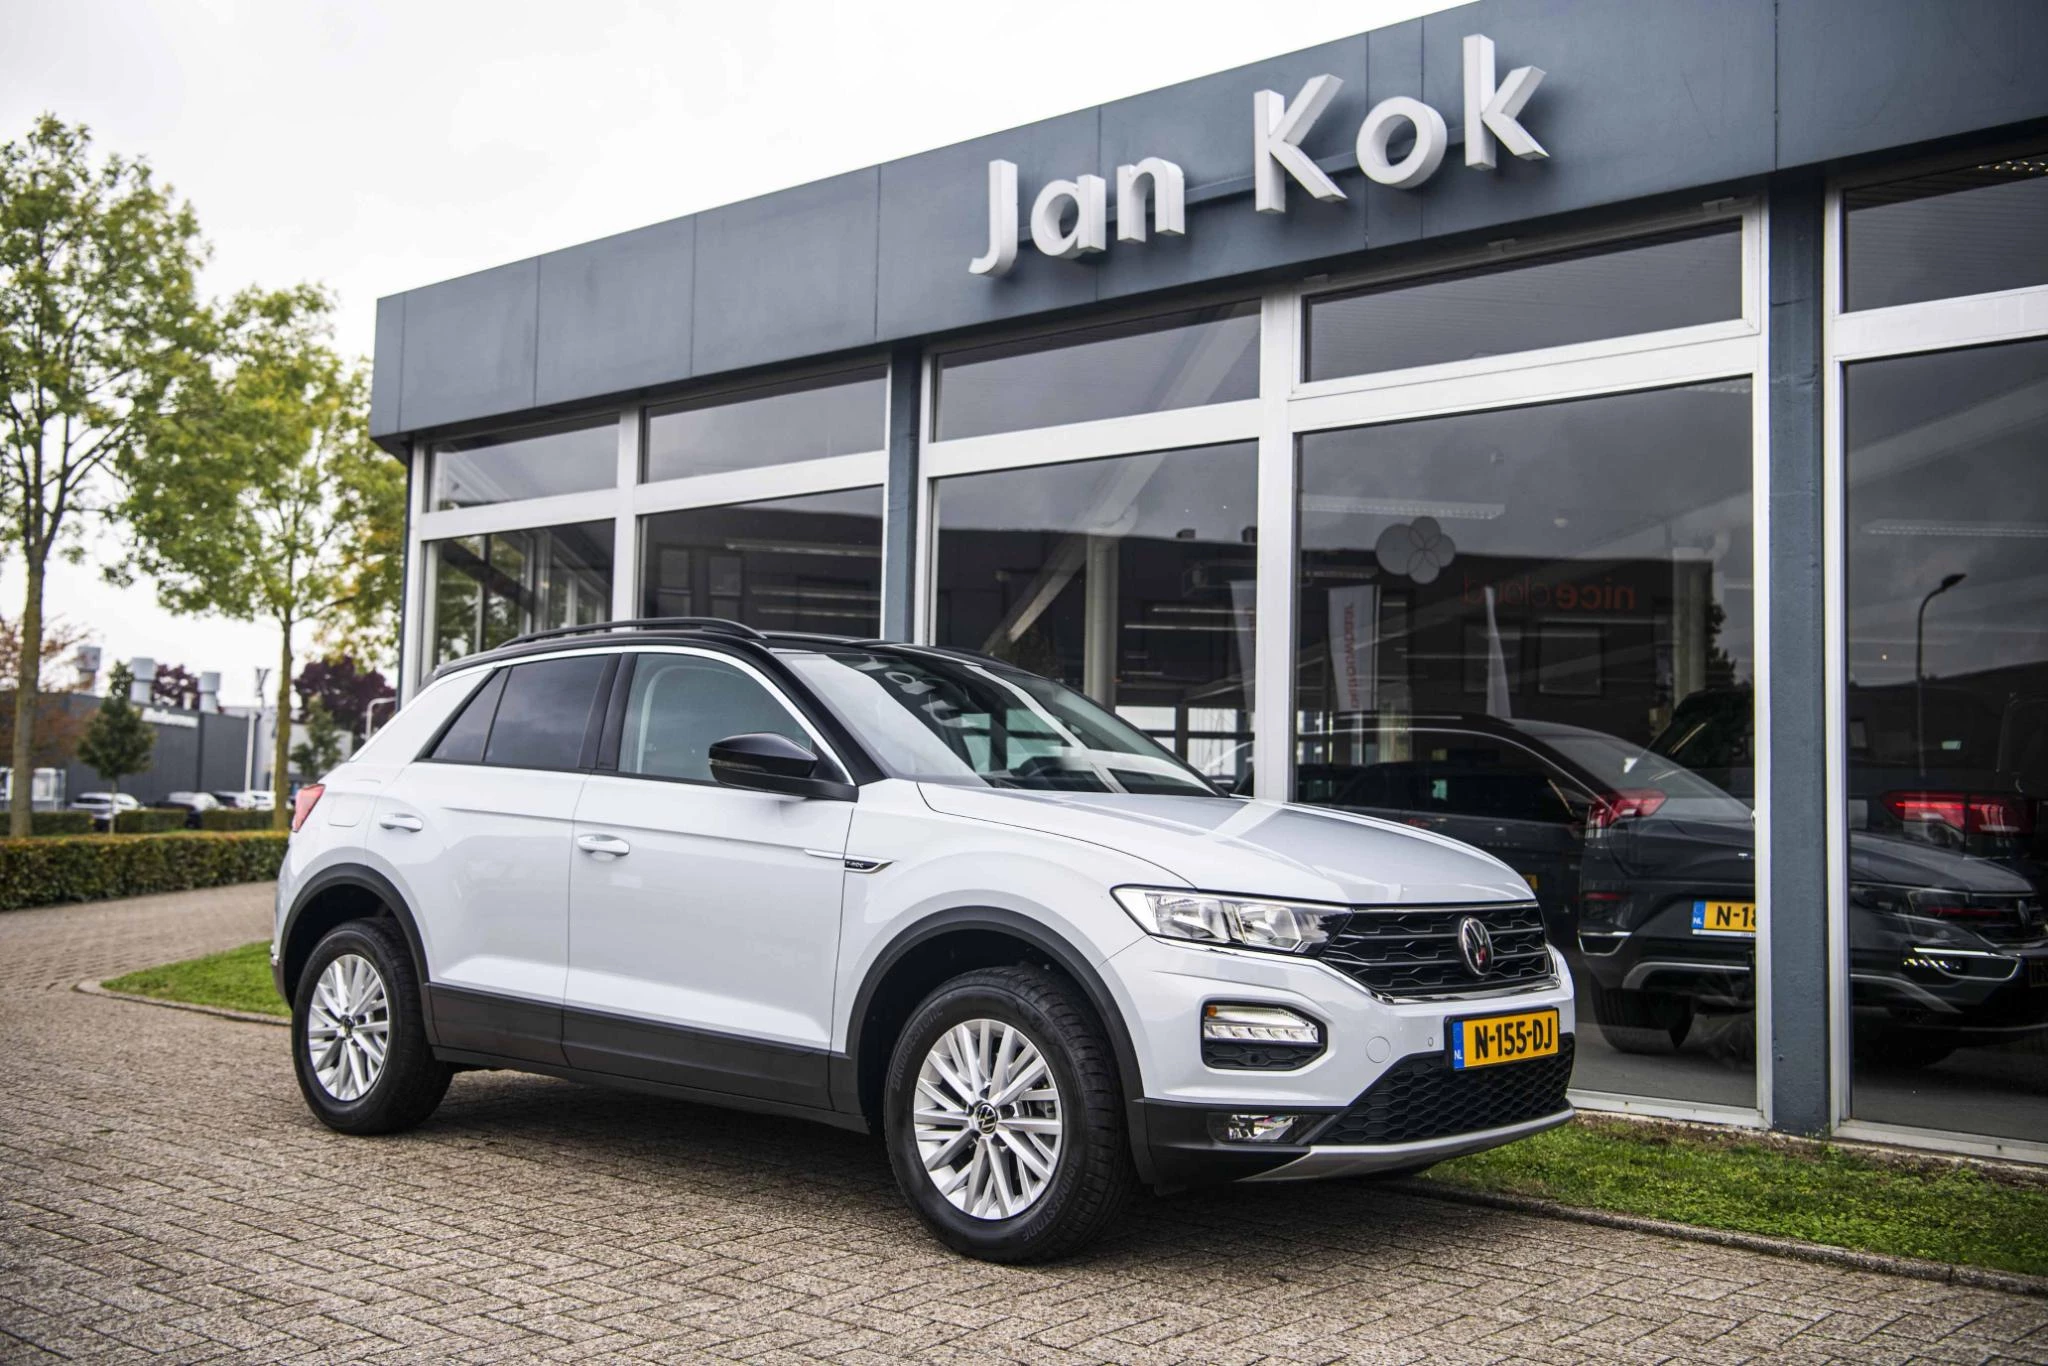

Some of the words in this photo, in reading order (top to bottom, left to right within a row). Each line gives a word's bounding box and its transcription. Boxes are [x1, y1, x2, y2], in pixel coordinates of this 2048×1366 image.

[968, 157, 1185, 277] Jan
[1253, 33, 1550, 215] Kok
[1454, 1049, 1463, 1060] NL
[1474, 1017, 1553, 1060] N-155-DJ
